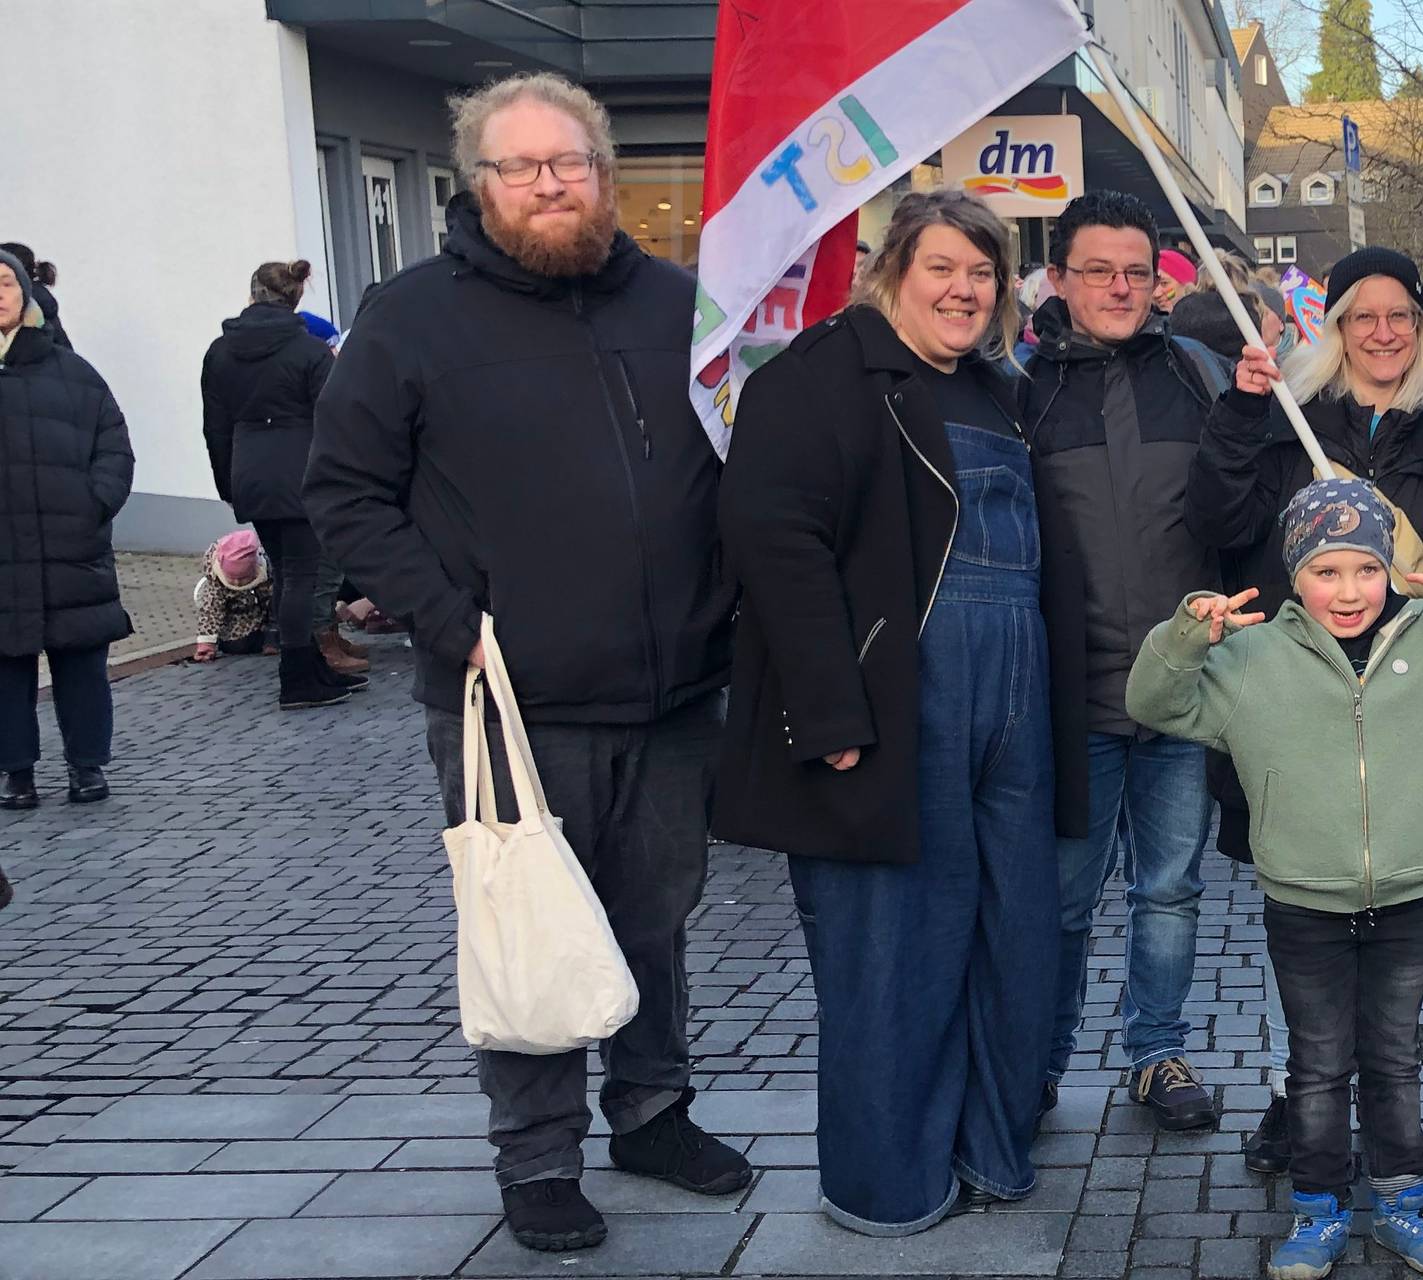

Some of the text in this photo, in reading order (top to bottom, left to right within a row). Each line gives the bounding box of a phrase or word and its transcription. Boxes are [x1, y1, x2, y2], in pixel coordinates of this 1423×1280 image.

[979, 130, 1054, 175] dm
[1346, 124, 1356, 162] P
[374, 184, 393, 225] 41
